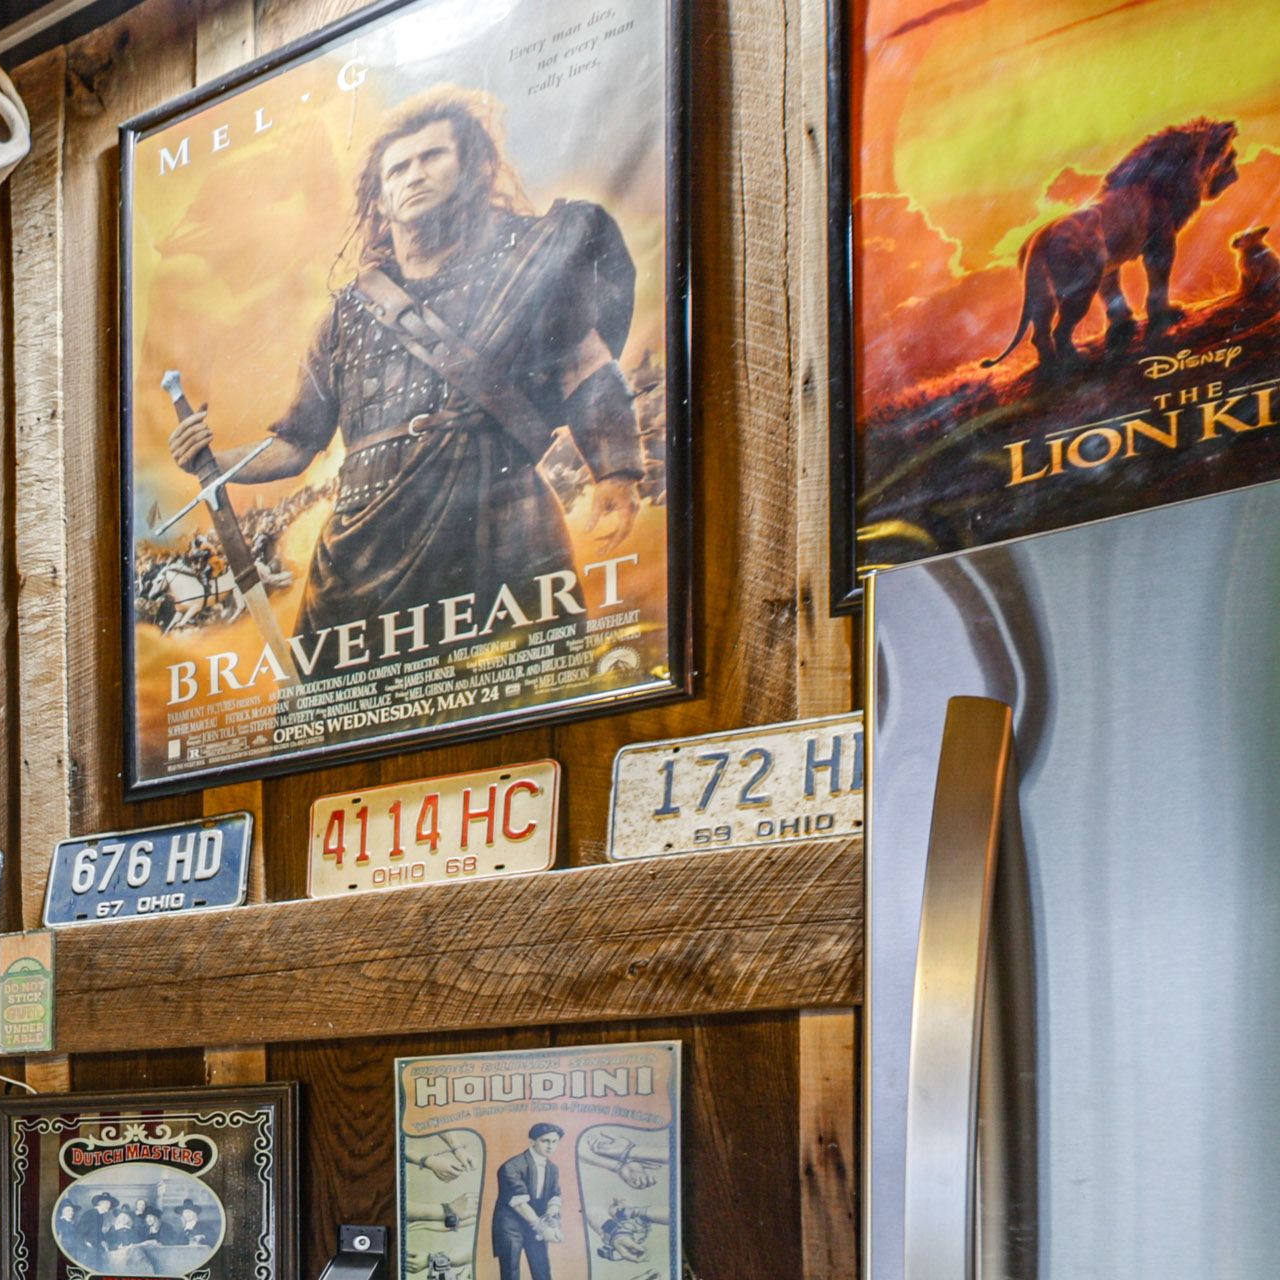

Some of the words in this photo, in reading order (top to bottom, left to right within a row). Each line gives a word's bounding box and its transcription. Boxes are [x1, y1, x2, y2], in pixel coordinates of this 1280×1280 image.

[509, 38, 546, 62] Every
[552, 23, 582, 43] man
[587, 8, 616, 28] dies,
[537, 53, 558, 72] not
[564, 36, 599, 59] every
[603, 19, 635, 41] man
[568, 57, 601, 78] lives.
[158, 107, 273, 176] MEL
[1153, 381, 1223, 409] THE
[1005, 410, 1183, 487] LION
[166, 554, 639, 706] BRAVEHEART
[368, 663, 402, 682] COMPANY
[453, 647, 471, 662] MEL
[528, 631, 546, 647] MEL
[546, 624, 577, 642] GIBSON
[586, 609, 640, 634] BRAVEHEART
[327, 701, 359, 718] RANDALL
[359, 694, 393, 712] WALLACE
[408, 686, 425, 701] MEL
[424, 680, 455, 697] GIBSON
[468, 673, 492, 688] ALAN
[541, 657, 568, 674] BRUCE
[568, 650, 595, 668] DAVEY
[403, 672, 426, 690] JAMES
[425, 666, 456, 682] HORNER
[557, 667, 590, 685] GIBSON
[273, 720, 325, 744] OPENS
[327, 697, 436, 733] WEDNESDAY,
[436, 689, 478, 712] MAY
[481, 686, 499, 703] 24
[653, 747, 775, 821] 172
[323, 794, 441, 868] 4114
[461, 778, 544, 851] HC
[693, 825, 732, 845] 69
[757, 813, 835, 838] OHIO
[71, 840, 154, 895] 676
[166, 829, 224, 885] HD
[372, 861, 427, 887] OHIO
[445, 856, 479, 877] 68
[95, 900, 125, 918] 67
[136, 893, 186, 914] OHIO
[8, 992, 42, 1004] STICK
[4, 1023, 44, 1034] UNDER
[414, 1065, 655, 1108] HOUDINI
[72, 1147, 124, 1167] DUTCH
[125, 1142, 204, 1167] MASTERS
